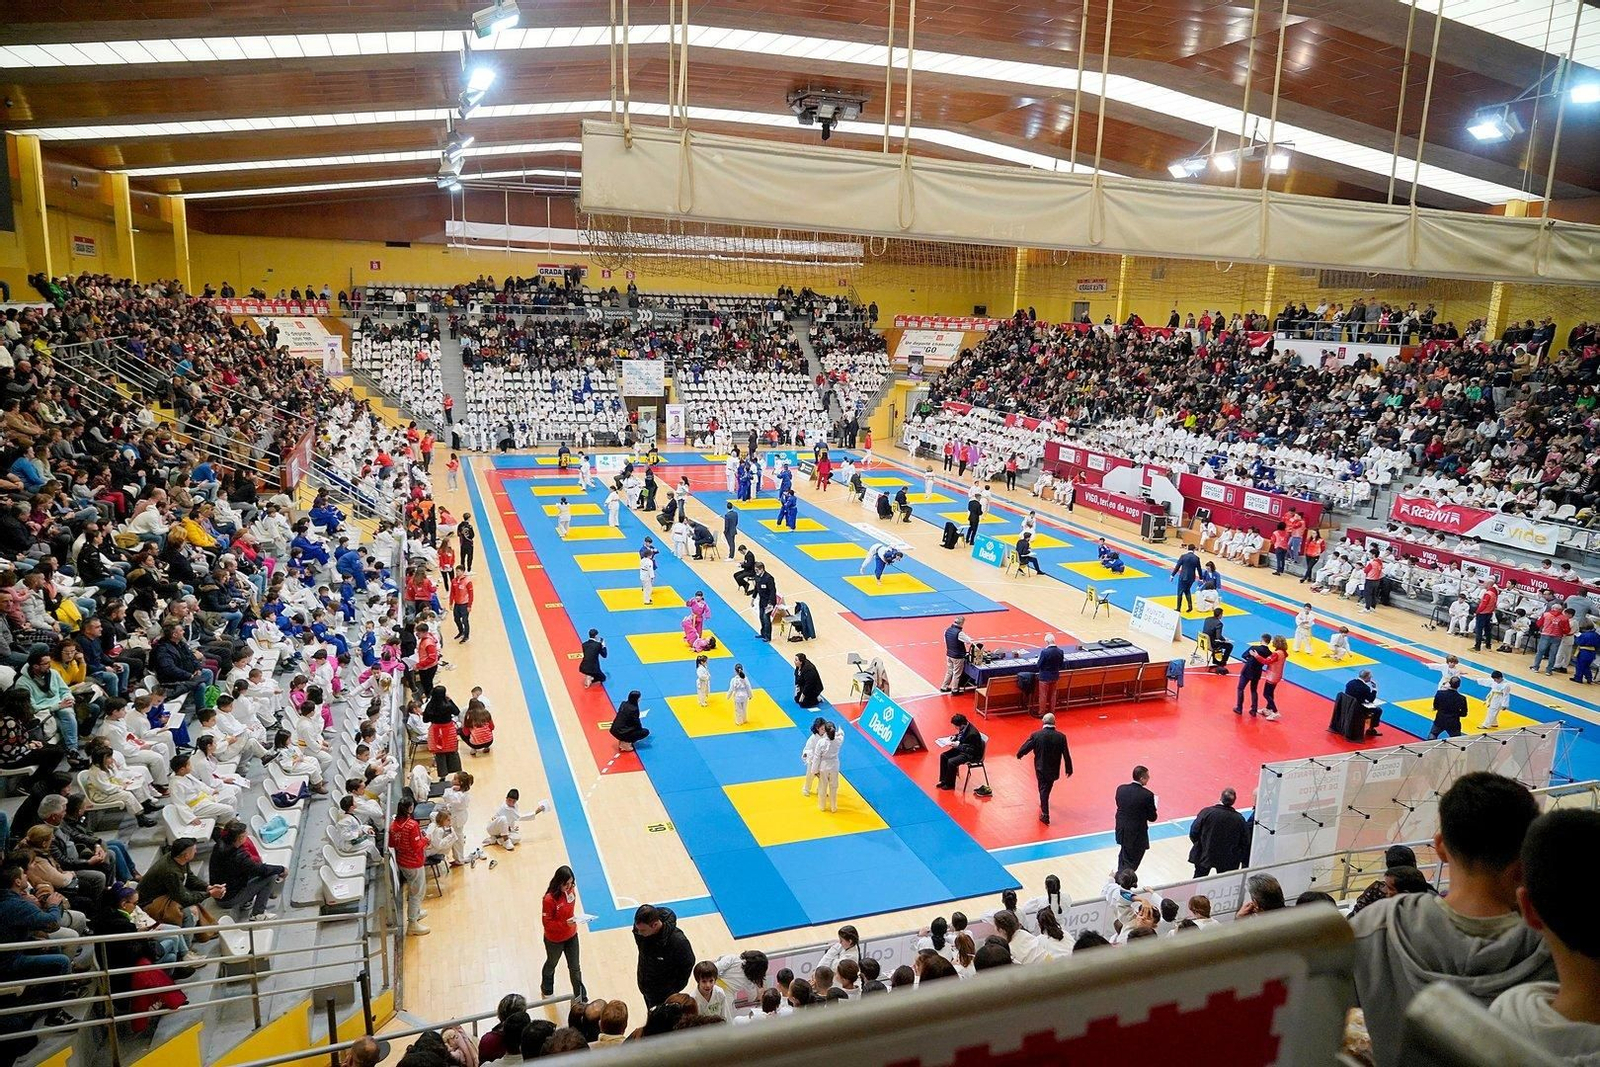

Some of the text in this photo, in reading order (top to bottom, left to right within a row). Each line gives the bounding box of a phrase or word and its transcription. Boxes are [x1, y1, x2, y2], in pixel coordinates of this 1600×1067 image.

[1203, 484, 1223, 494] CONCELLO
[1246, 495, 1268, 505] CONCELLO
[1254, 502, 1265, 510] VIGO
[1117, 502, 1125, 511] de
[1125, 506, 1139, 517] xogo
[1411, 505, 1452, 523] Recalvi
[979, 547, 996, 562] Daedo
[1145, 607, 1165, 619] XUNTA
[1143, 613, 1175, 631] DE GALICIA
[869, 712, 892, 742] Daedo
